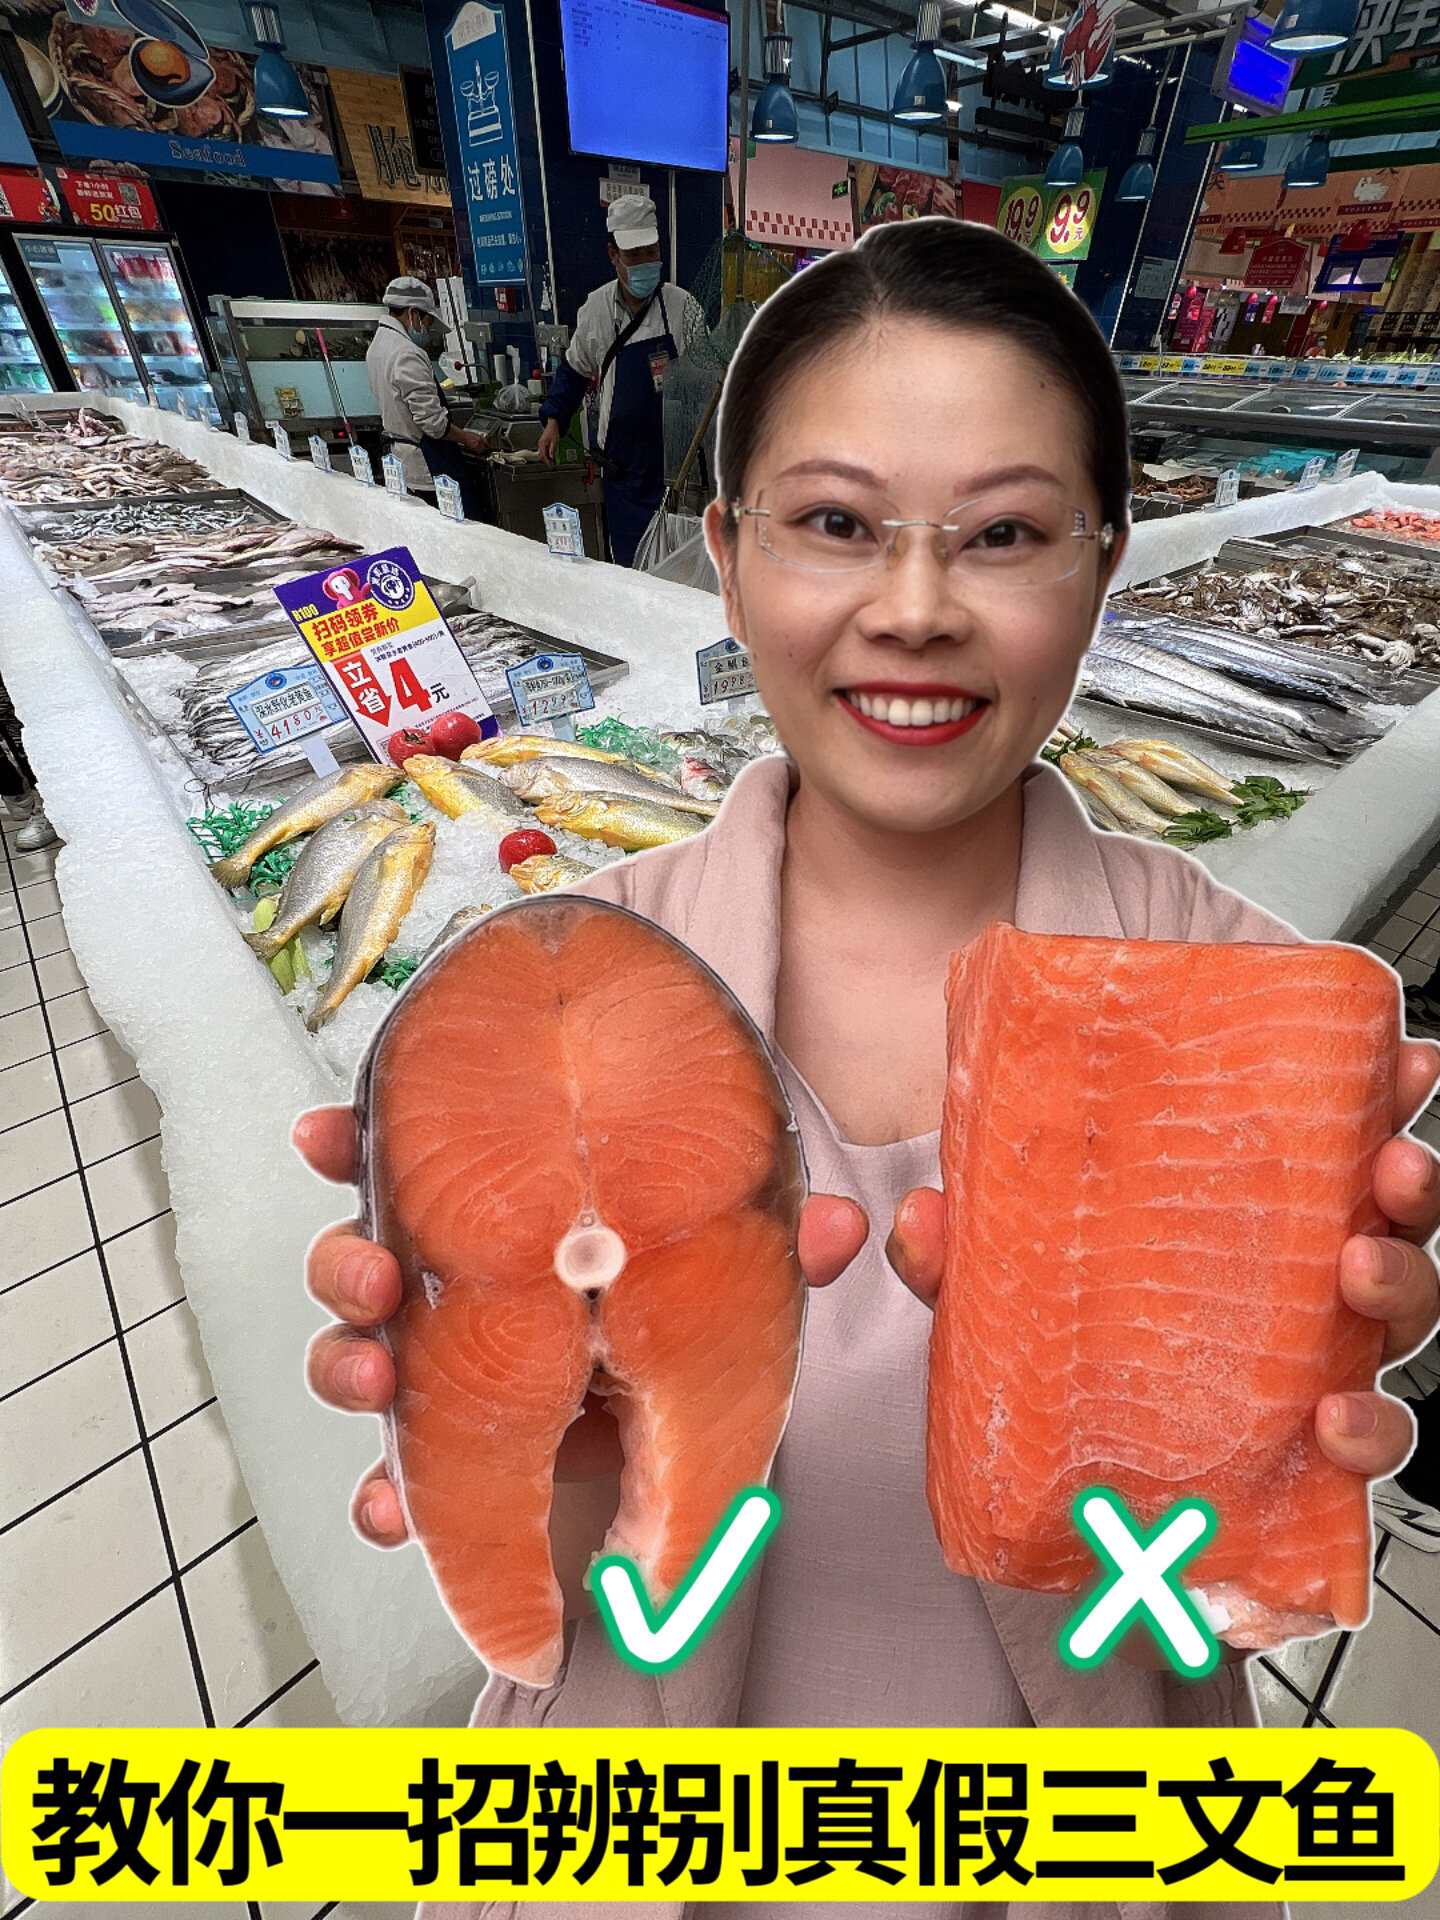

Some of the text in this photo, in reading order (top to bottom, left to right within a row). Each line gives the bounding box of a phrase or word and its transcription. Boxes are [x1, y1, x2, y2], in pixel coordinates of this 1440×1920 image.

[167, 139, 246, 168] Seafood
[467, 153, 516, 202] 过磅处
[312, 603, 378, 642] 扫码领券
[320, 616, 400, 657] 享超值尝新价
[341, 660, 387, 715] 立省
